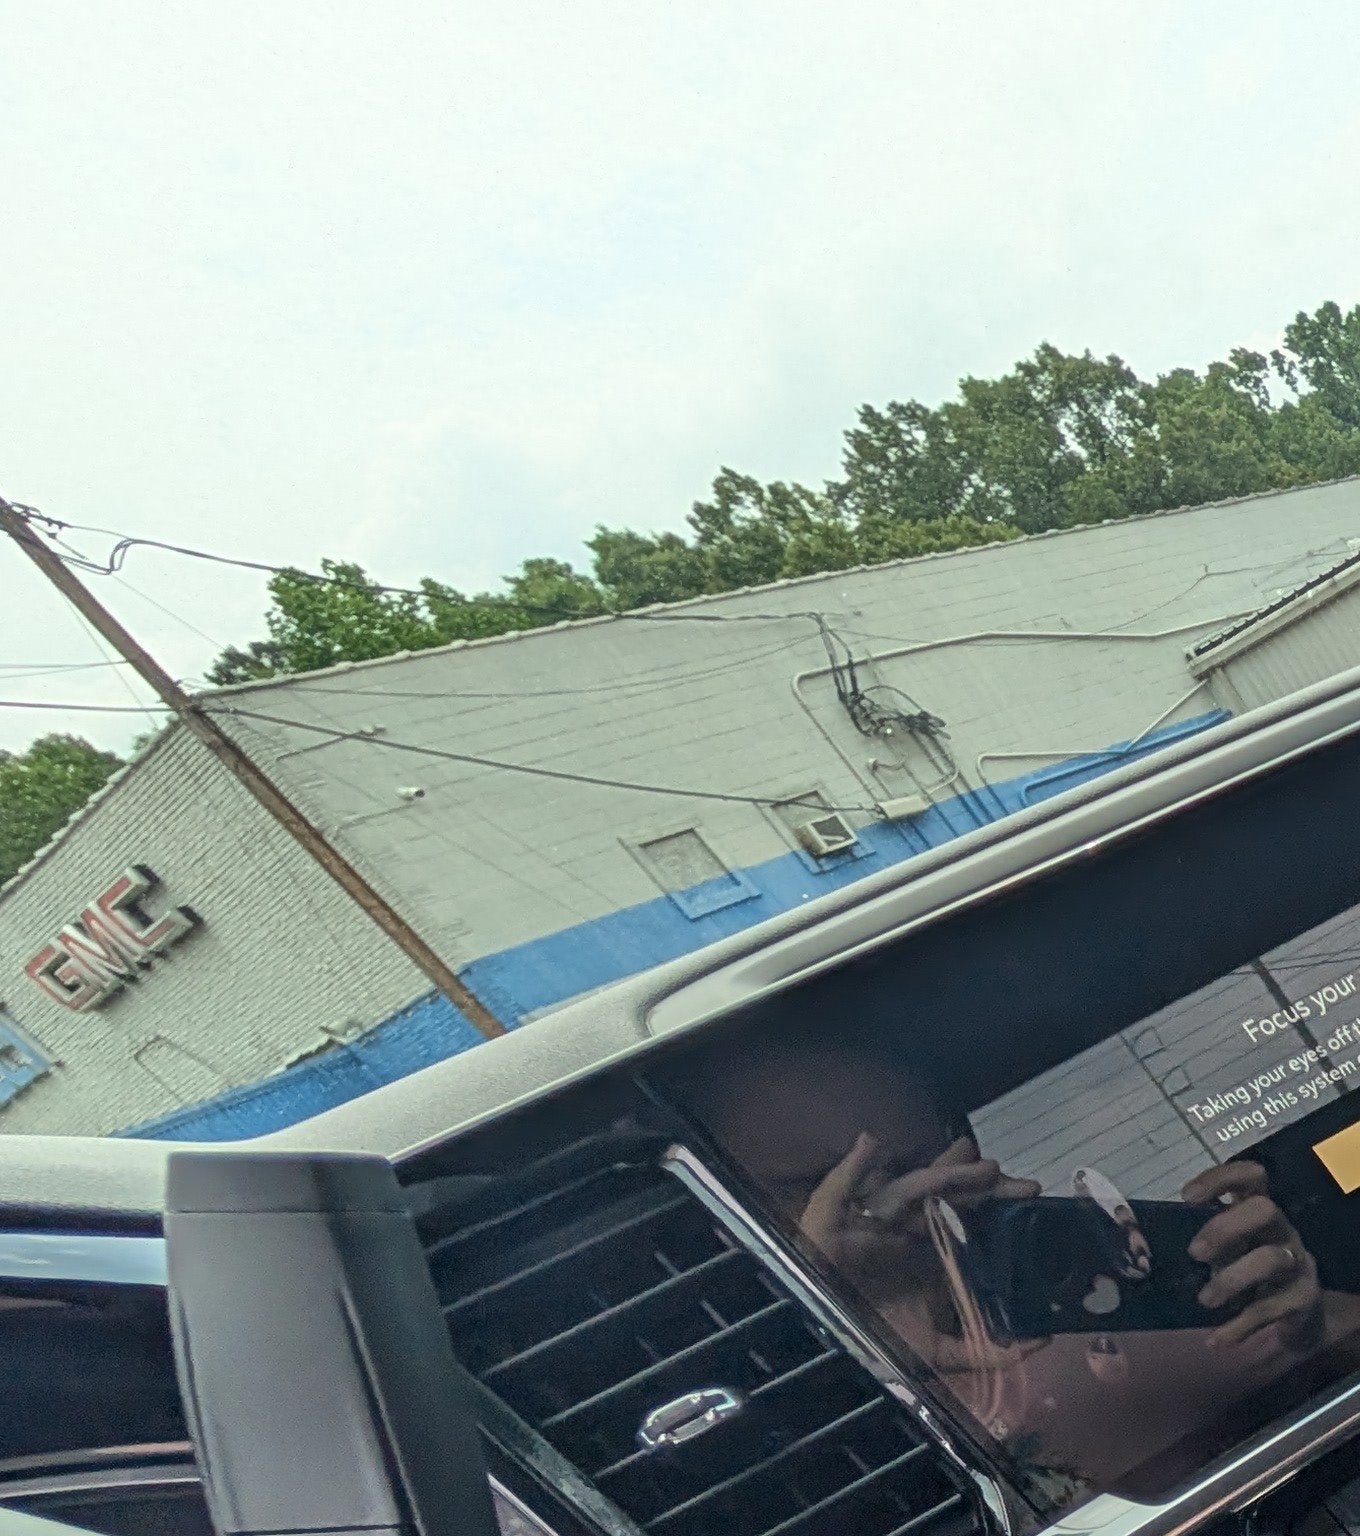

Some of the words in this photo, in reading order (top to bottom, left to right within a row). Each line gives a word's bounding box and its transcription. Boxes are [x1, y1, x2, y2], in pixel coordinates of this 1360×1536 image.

[24, 865, 197, 1012] GMC
[1241, 999, 1311, 1043] Focus
[1310, 973, 1357, 1016] your
[1187, 1085, 1252, 1123] Taking
[1249, 1064, 1287, 1098] your
[1289, 1045, 1328, 1073] eyes
[1328, 1024, 1354, 1050] off
[1217, 1107, 1267, 1142] using
[1264, 1091, 1298, 1116] this
[1298, 1061, 1358, 1099] system
